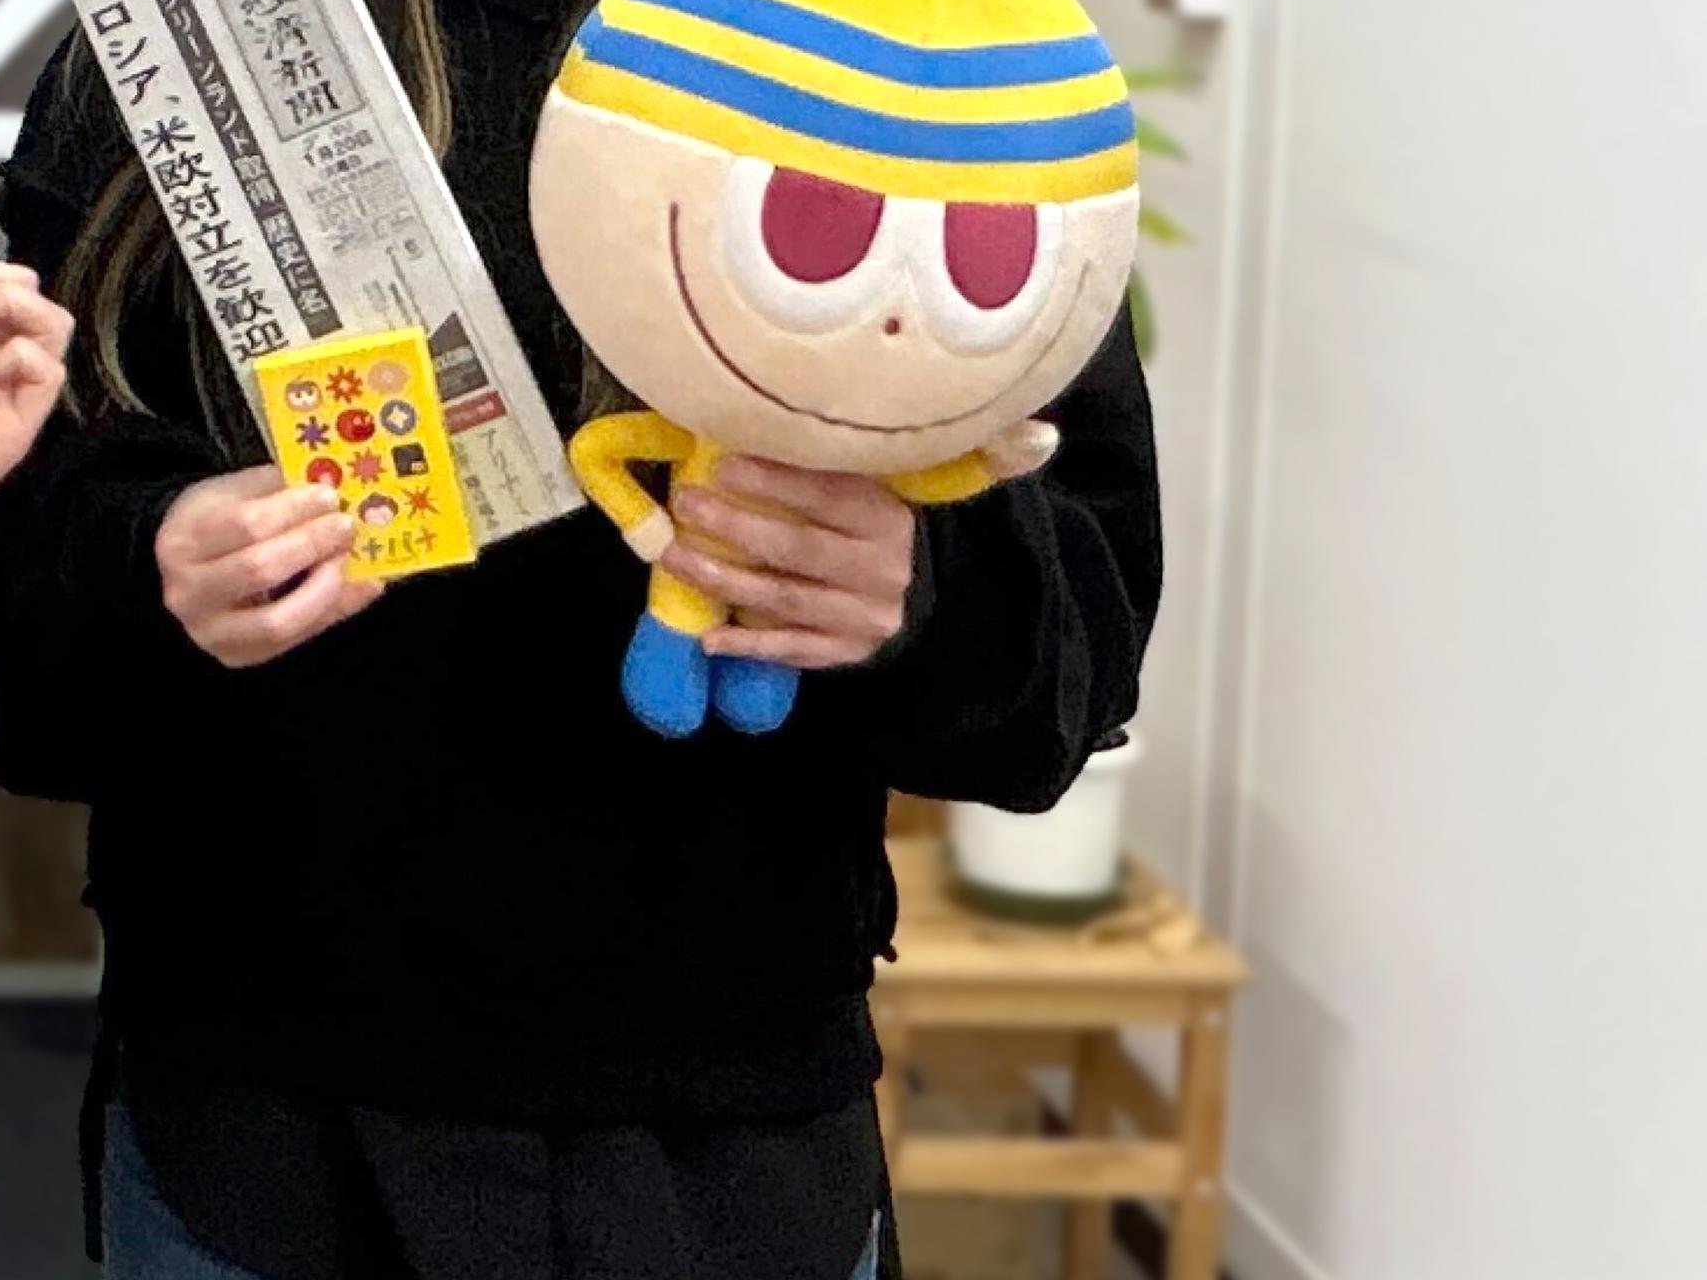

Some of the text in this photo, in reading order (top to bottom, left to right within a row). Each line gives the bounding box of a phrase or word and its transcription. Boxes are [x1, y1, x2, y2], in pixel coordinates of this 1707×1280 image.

[90, 0, 289, 363] ロシア、米欧対立を歓迎
